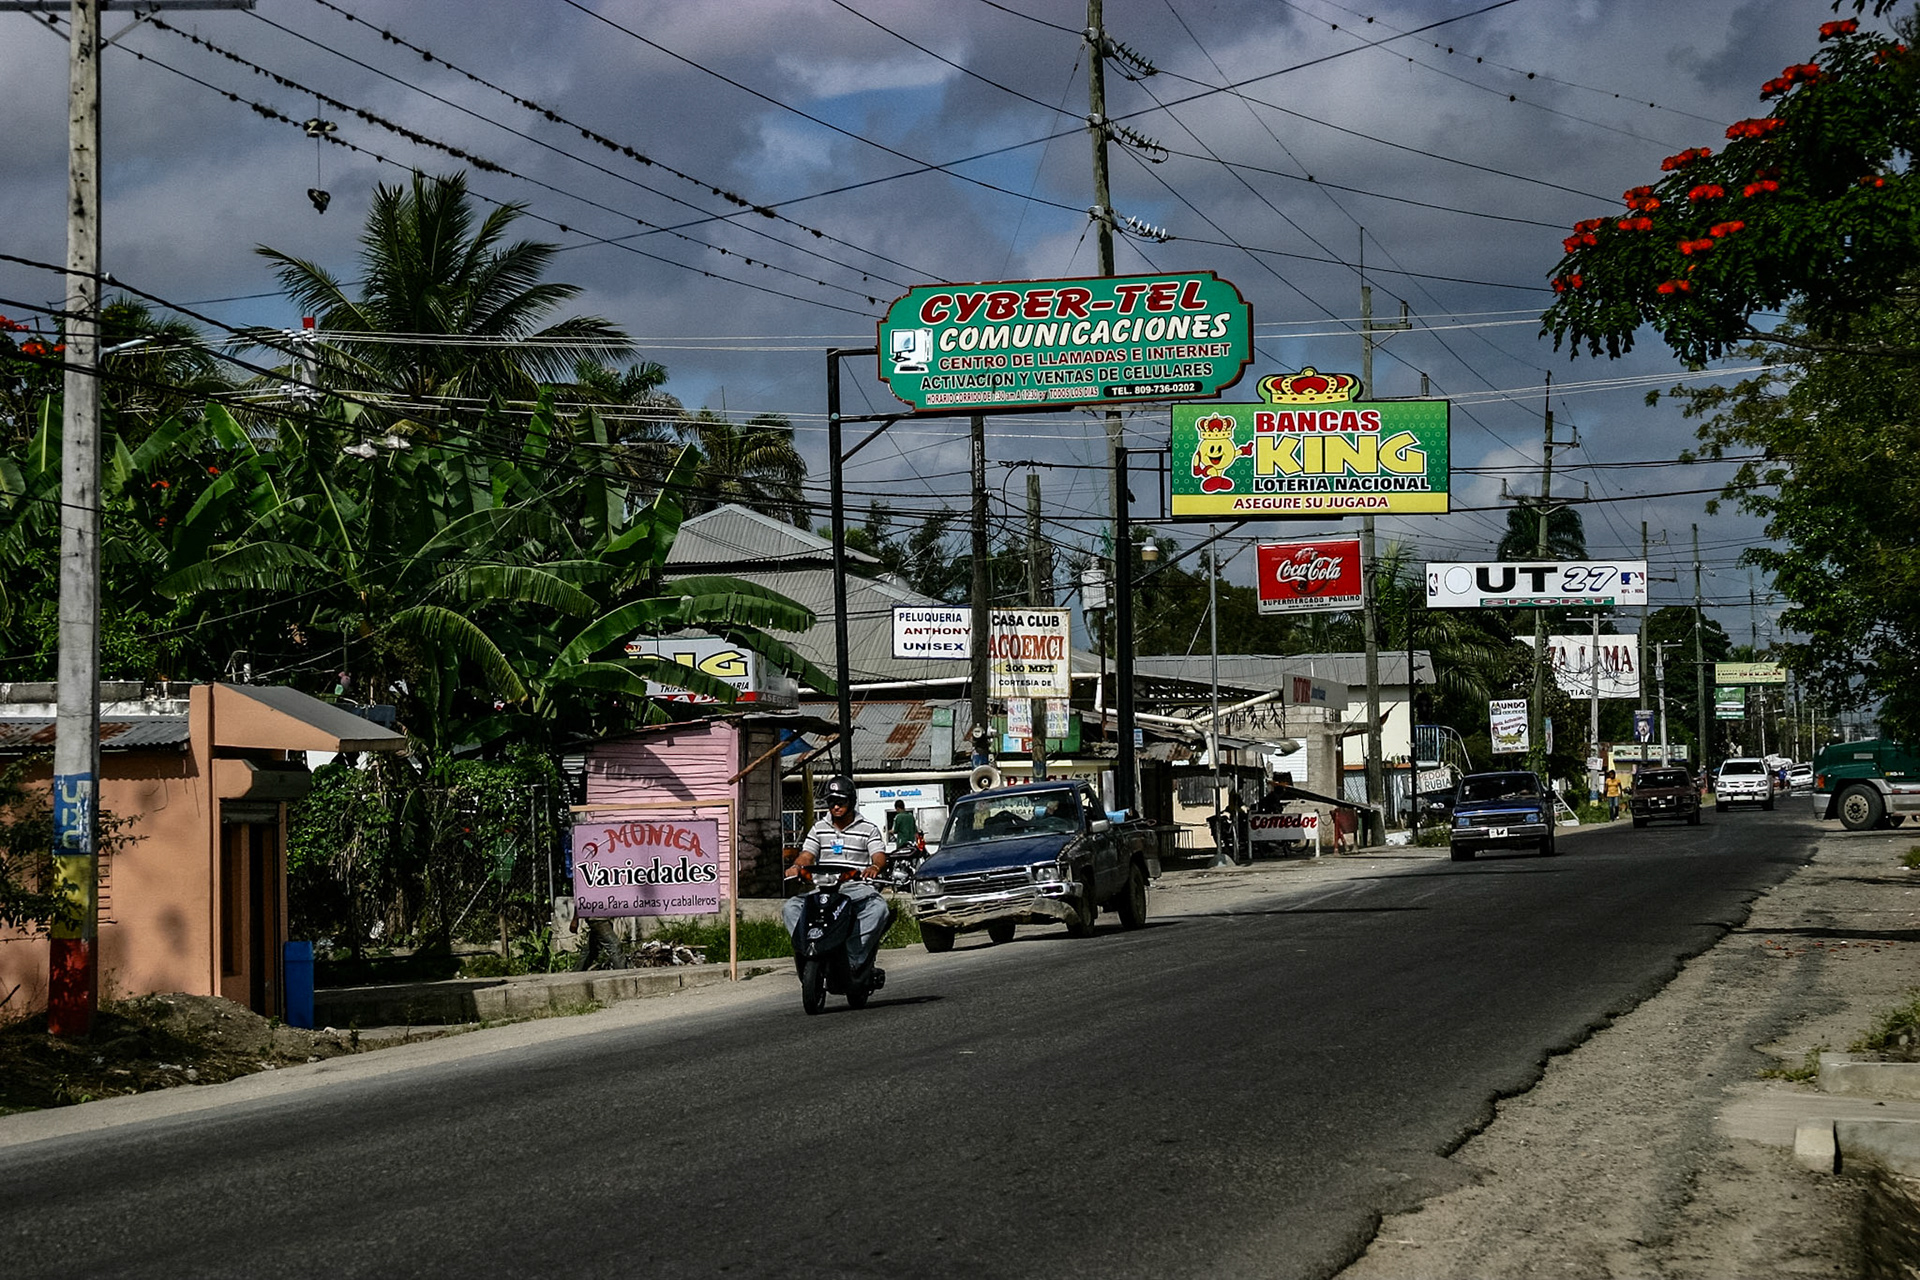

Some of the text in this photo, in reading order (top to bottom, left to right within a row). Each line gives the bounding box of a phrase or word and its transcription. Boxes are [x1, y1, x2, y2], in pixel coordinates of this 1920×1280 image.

[920, 279, 1207, 325] CYBER-TEL
[938, 313, 1231, 352] COMUNICACIONES
[939, 342, 1231, 370] CENTRO DE LLAMADAS E INTERNET
[921, 362, 1213, 390] ACTIVACION Y VENTAS DE CELULARES
[1050, 387, 1071, 399] TODOS
[1071, 387, 1083, 398] LOS
[1084, 386, 1098, 397] DIAS
[1112, 383, 1195, 396] TEL. 809-736-0202
[1255, 410, 1380, 433] BANCAS
[1254, 432, 1427, 476] KING
[1254, 477, 1430, 491] LOTERIA NACIONAL
[1232, 496, 1388, 510] ASEGURE SU JUGADA
[1276, 557, 1343, 583] Coca-Cola
[1561, 566, 1618, 592] 27
[1481, 597, 1613, 607] SPORT
[899, 612, 962, 623] PELUQUERIA
[991, 615, 1060, 627] CASA CLUB
[904, 627, 971, 635] ANTHONY
[903, 642, 964, 651] UNISEX
[987, 634, 1065, 660] ACOEMCI
[1005, 664, 1025, 672] 300
[998, 679, 1039, 687] CORTESIA
[1425, 778, 1452, 791] RUBIA
[603, 823, 703, 857] MONICA
[577, 856, 718, 888] Variedades
[608, 896, 628, 909] Para
[633, 896, 661, 909] damas
[661, 899, 670, 911] y
[671, 895, 717, 907] caballeros
